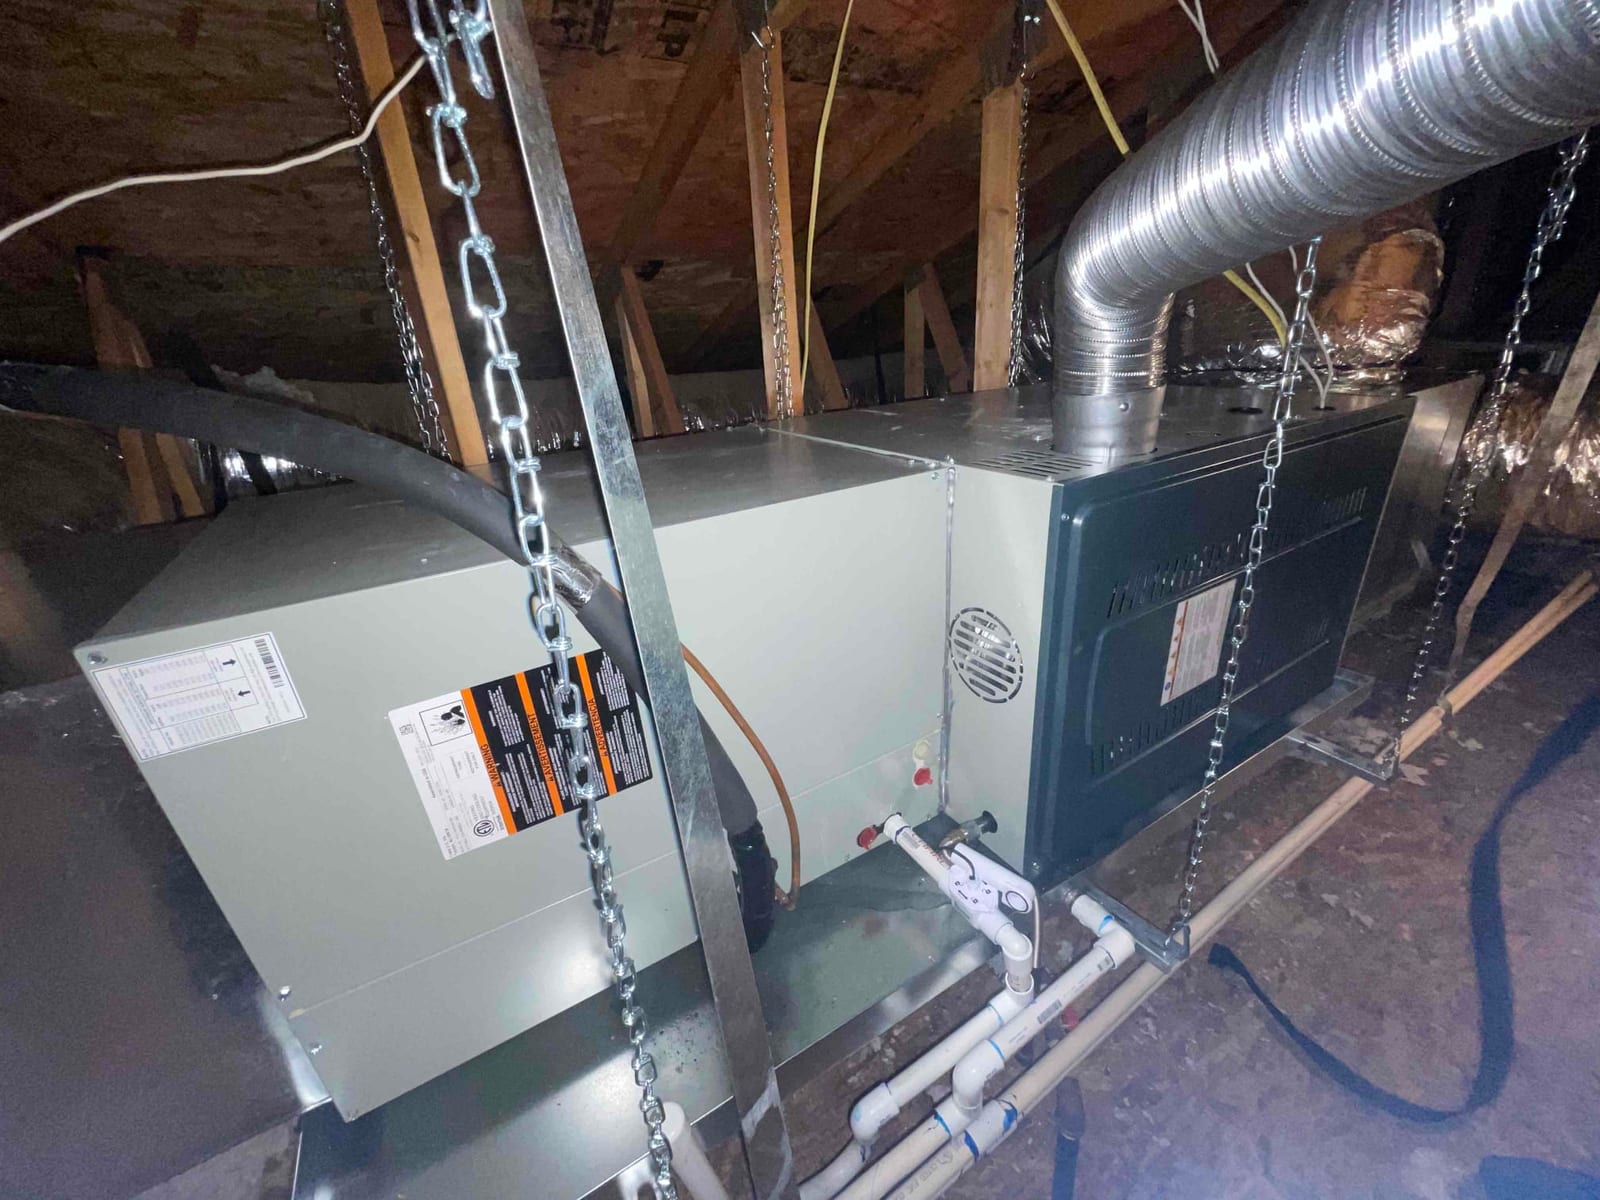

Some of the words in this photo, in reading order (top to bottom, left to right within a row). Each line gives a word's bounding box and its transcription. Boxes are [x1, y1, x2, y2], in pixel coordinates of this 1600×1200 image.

[527, 714, 554, 776] AVERTISSEMENT
[588, 697, 607, 750] ADVERTENCIA
[480, 743, 500, 782] WARNING
